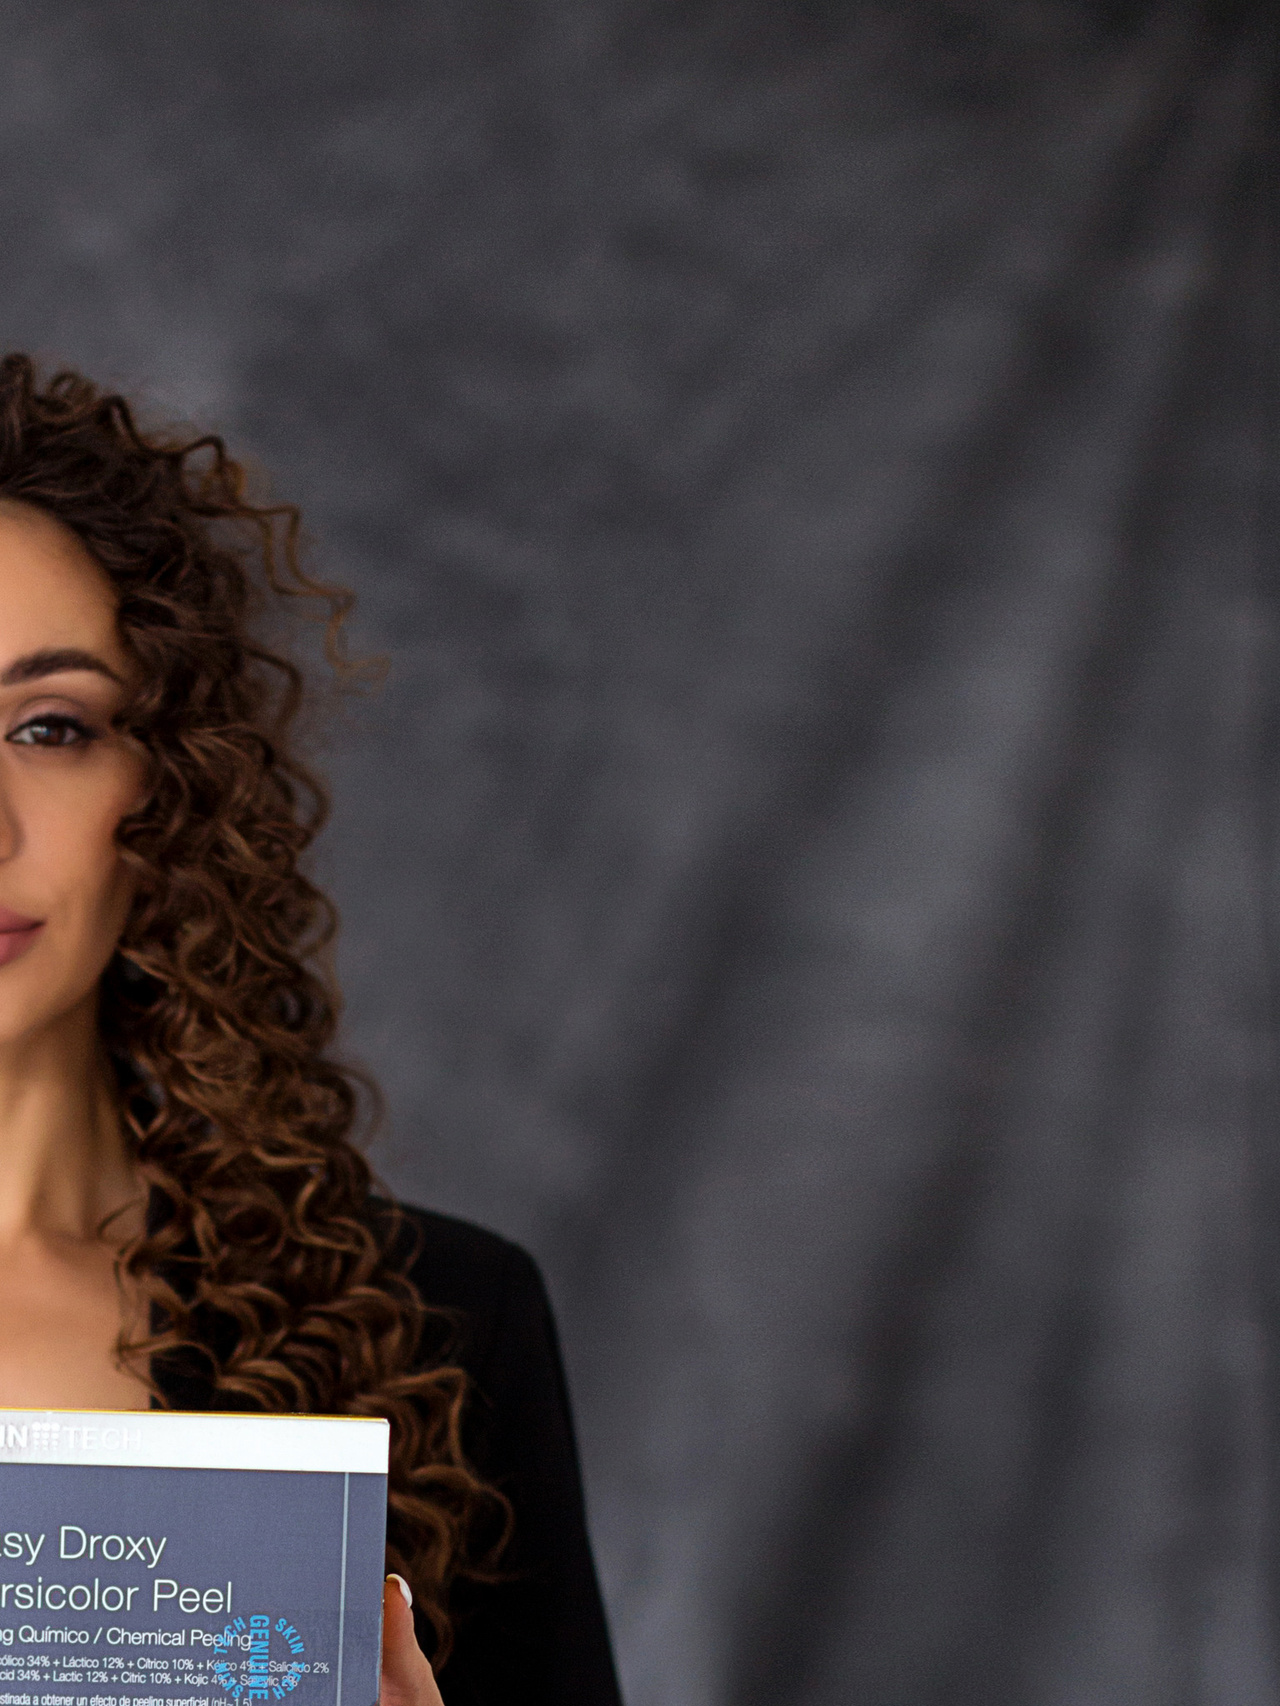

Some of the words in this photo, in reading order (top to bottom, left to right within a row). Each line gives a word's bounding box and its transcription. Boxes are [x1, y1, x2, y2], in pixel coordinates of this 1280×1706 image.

[63, 1425, 142, 1451] TECH
[59, 1525, 167, 1569] Droxy
[153, 1579, 232, 1614] Peel
[18, 1625, 90, 1644] Químico
[92, 1626, 103, 1645] /
[106, 1627, 186, 1646] Chemical
[190, 1629, 252, 1651] Peeling
[274, 1617, 305, 1655] SKIN
[26, 1655, 50, 1668] 34%
[52, 1658, 61, 1667] +
[62, 1656, 99, 1669] Láctico
[102, 1657, 125, 1669] 12%
[126, 1661, 135, 1669] +
[136, 1657, 169, 1670] Cítrico
[172, 1659, 194, 1671] 10%
[196, 1662, 204, 1670] +
[312, 1661, 330, 1674] 2%
[248, 1614, 270, 1700] GENUINE
[17, 1669, 40, 1682] 34%
[42, 1673, 51, 1681] +
[53, 1670, 83, 1682] Lactic
[86, 1671, 109, 1683] 12%
[111, 1674, 119, 1682] +
[120, 1671, 147, 1684] Citric
[149, 1672, 172, 1684] 10%
[174, 1675, 182, 1683] +
[183, 1673, 209, 1687] Kojic
[32, 1696, 39, 1706] a
[41, 1694, 74, 1706] obtener
[76, 1696, 88, 1706] un
[89, 1695, 117, 1706] efecto
